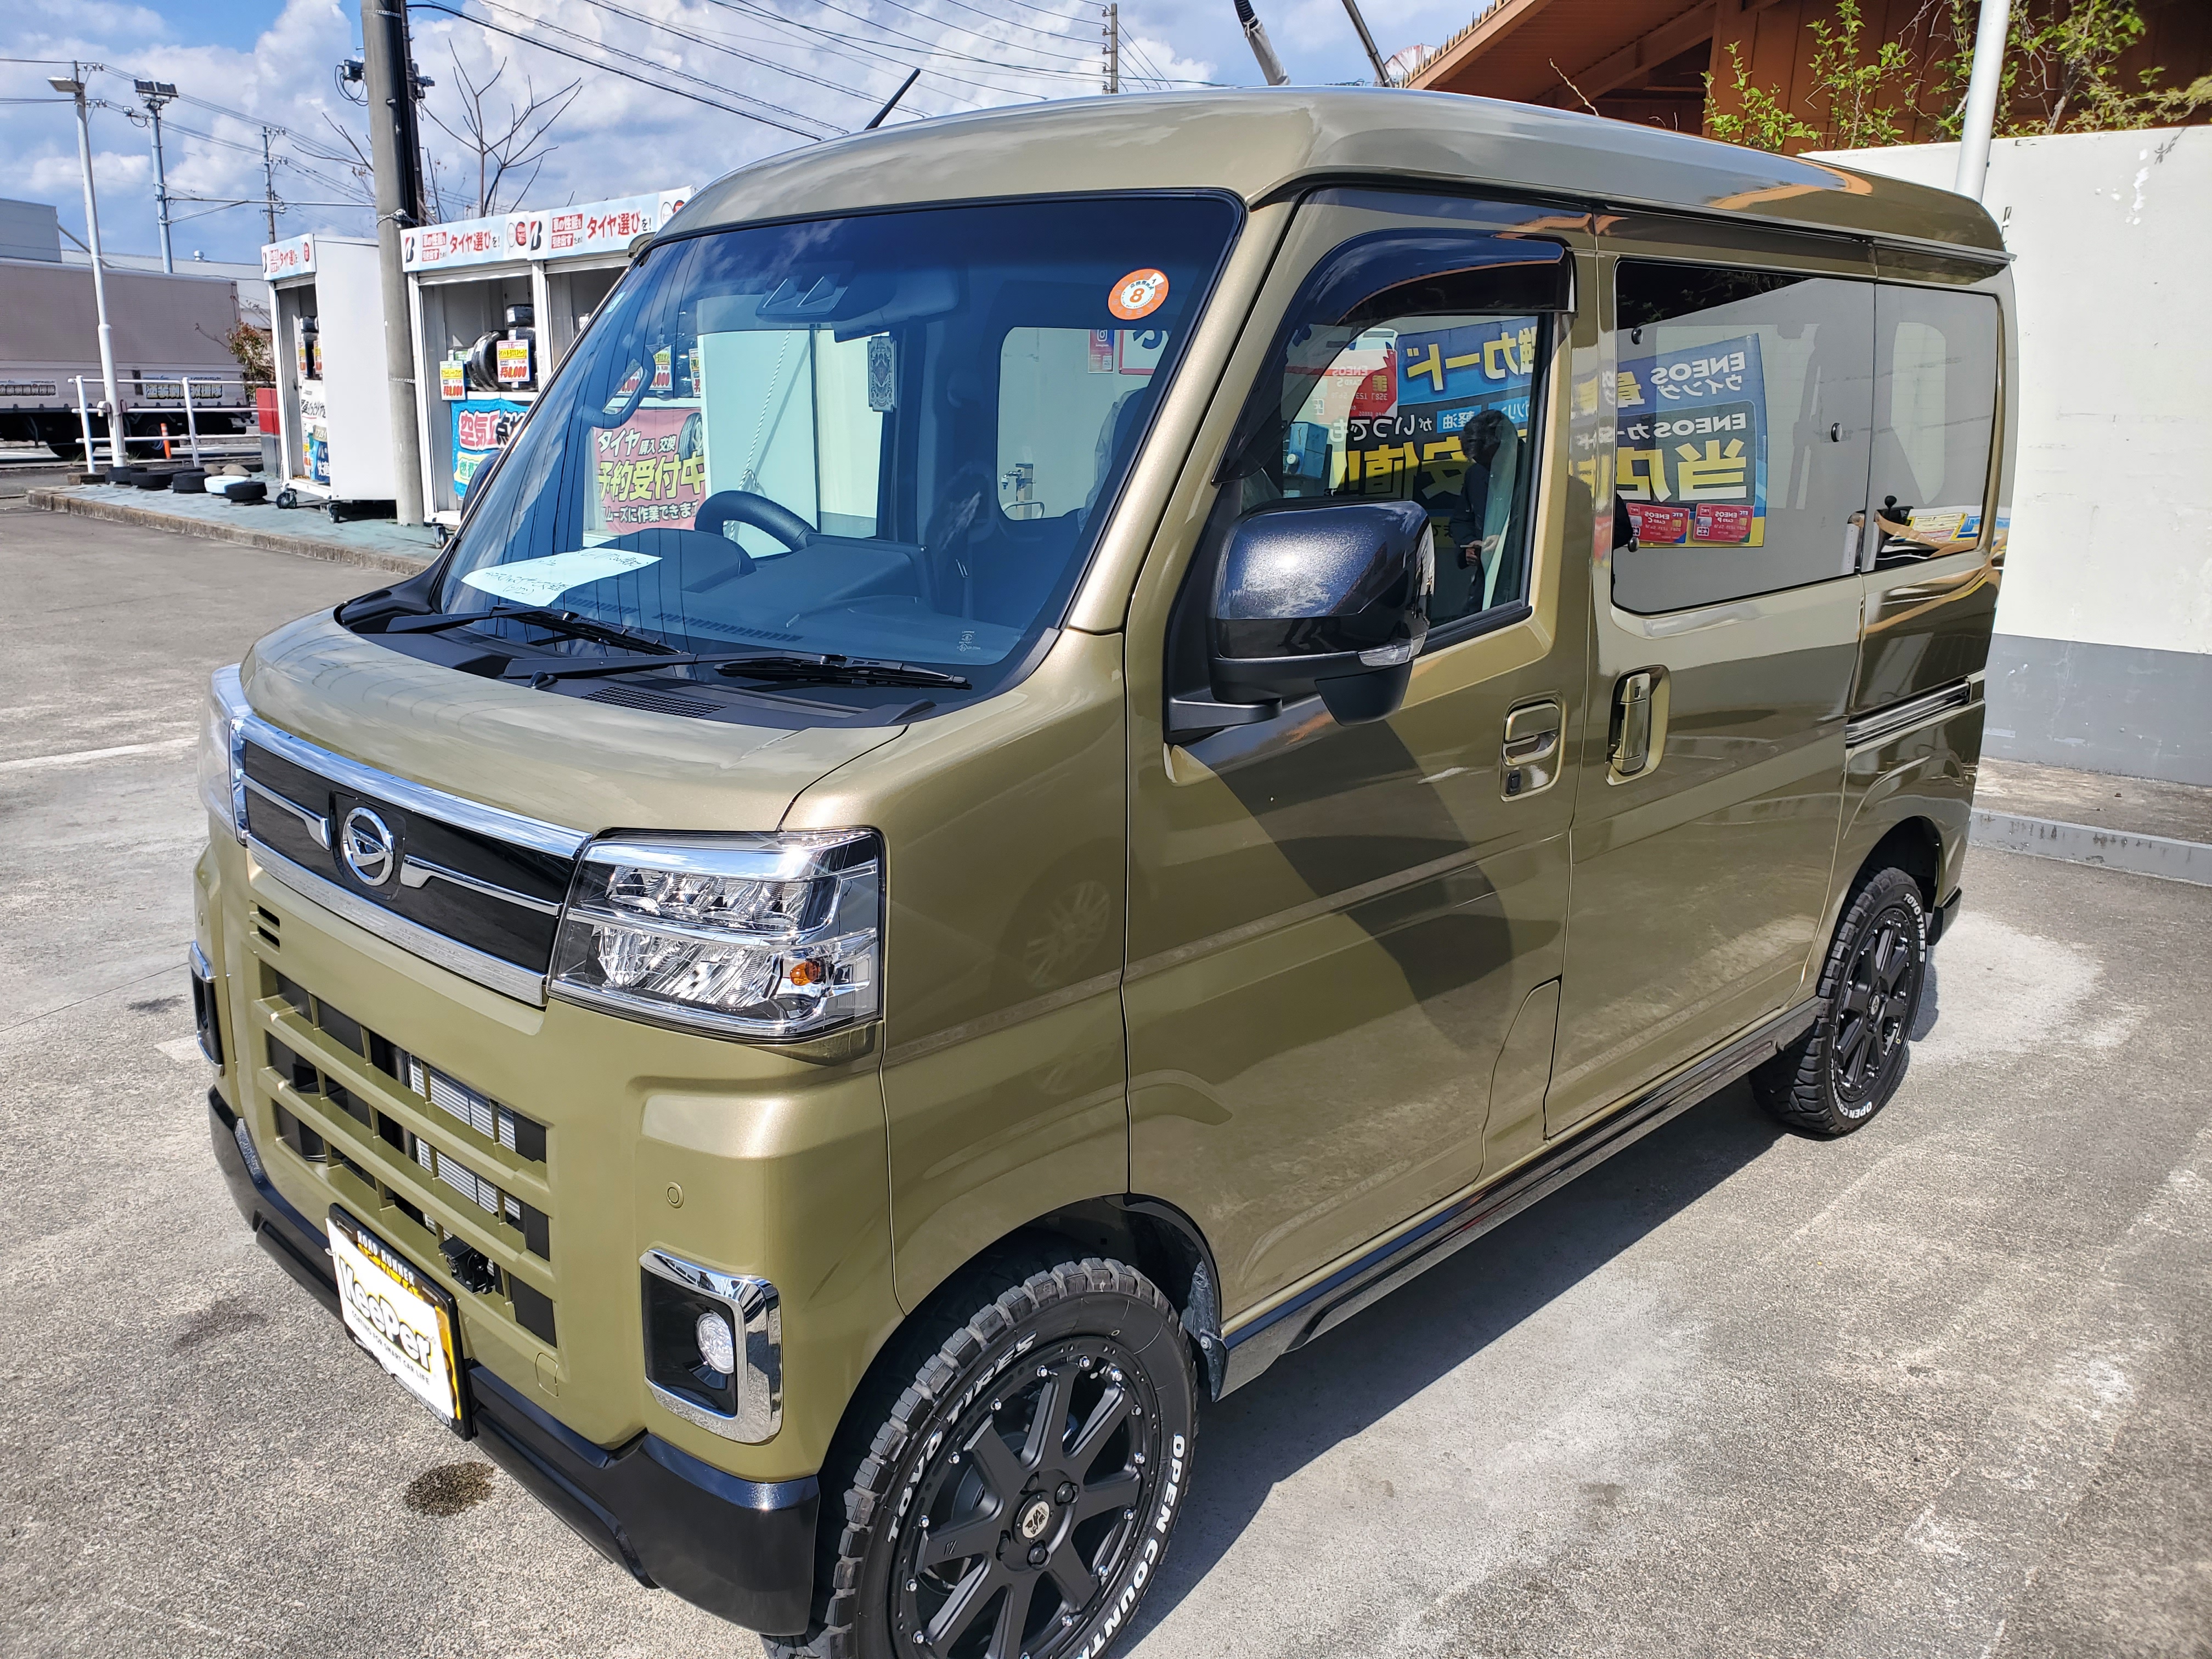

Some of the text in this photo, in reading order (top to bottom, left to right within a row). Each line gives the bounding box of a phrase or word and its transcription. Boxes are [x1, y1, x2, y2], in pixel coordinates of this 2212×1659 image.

[1130, 288, 1144, 302] 8
[597, 429, 641, 457] タイヤ
[597, 450, 706, 501] 予約受付中
[1903, 893, 1926, 962] TOYO TIRES
[1848, 1102, 1872, 1119] OPEN
[357, 1230, 379, 1259] ROAD
[381, 1249, 416, 1286] RUNNER
[373, 1334, 383, 1346] FOR
[384, 1343, 402, 1363] SMART
[403, 1360, 414, 1374] CAR
[416, 1369, 430, 1386] LIFE
[887, 1330, 1037, 1543] TOYO TIRES
[1154, 1434, 1186, 1535] OPEN
